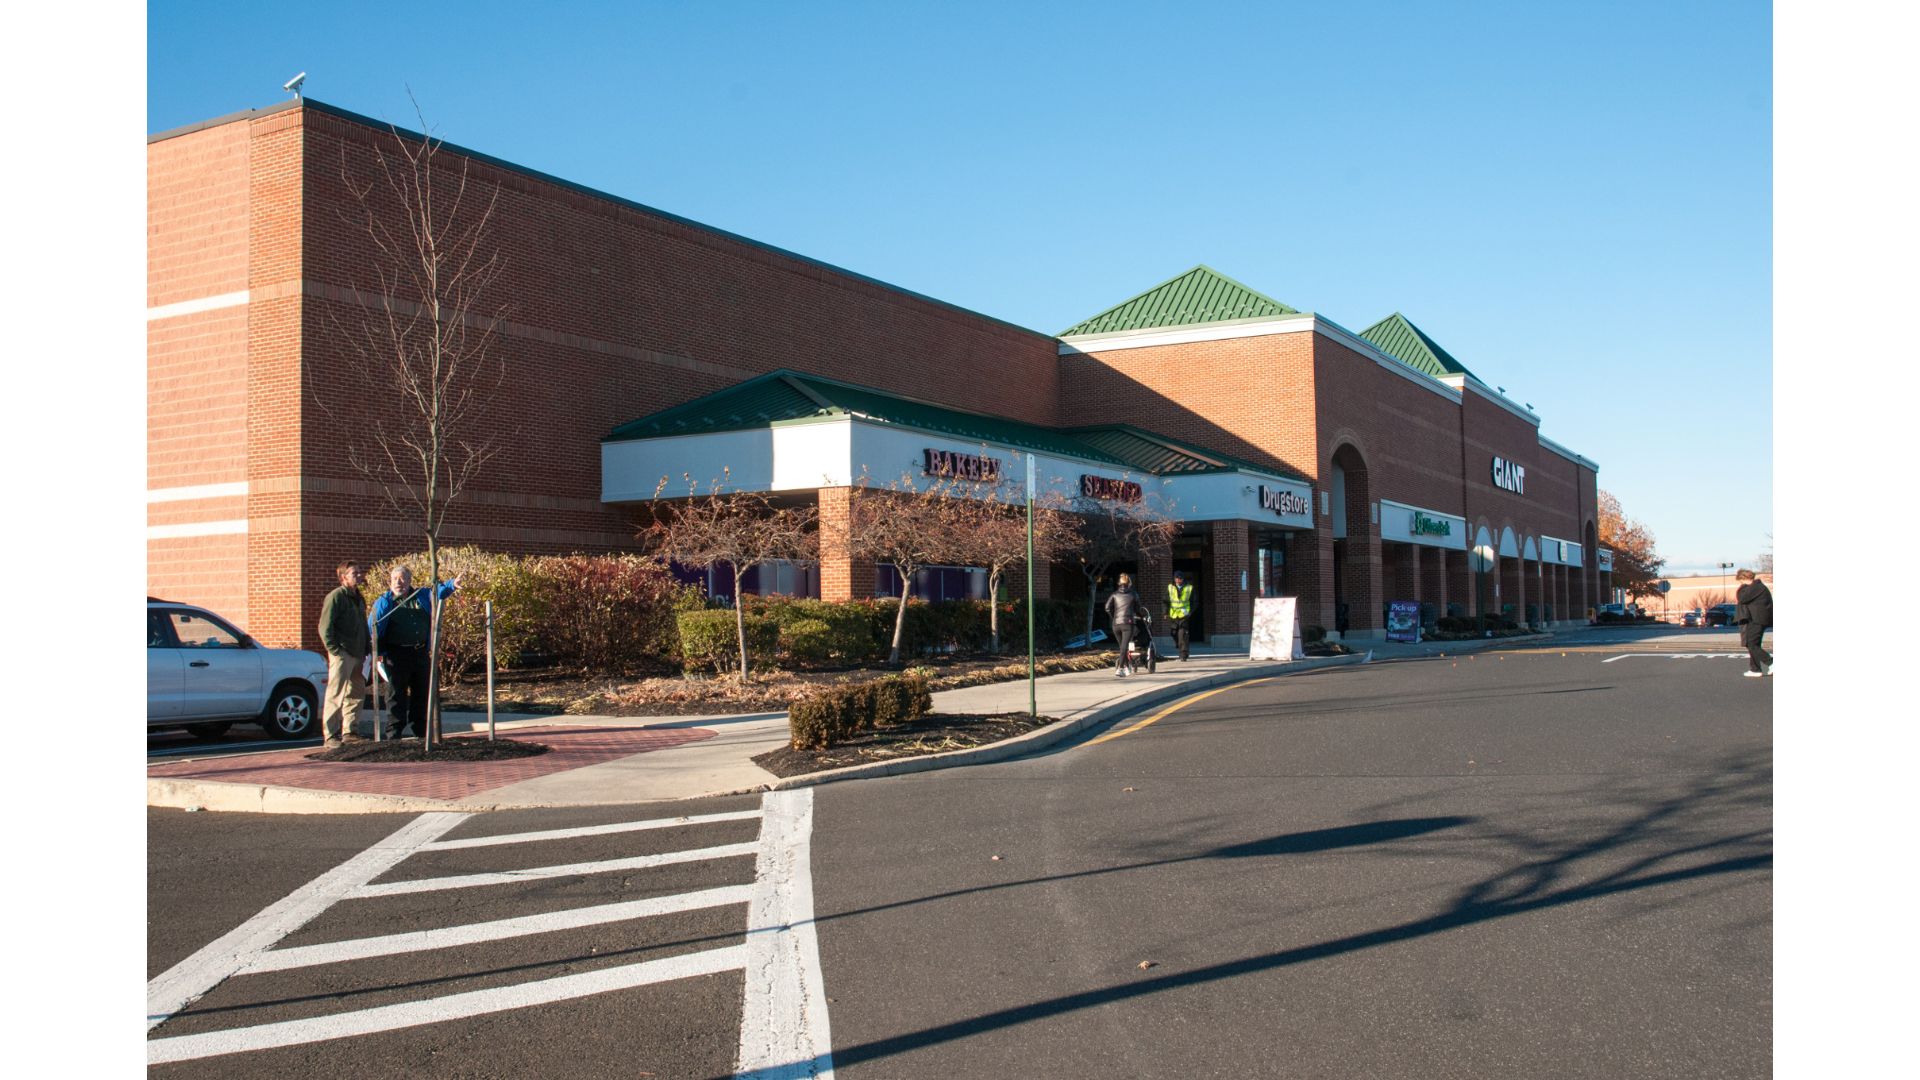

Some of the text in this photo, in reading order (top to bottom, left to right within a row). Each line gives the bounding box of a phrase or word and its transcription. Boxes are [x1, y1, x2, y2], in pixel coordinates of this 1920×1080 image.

[925, 448, 1002, 484] BAKERY
[1493, 456, 1525, 495] GIANT
[1261, 485, 1309, 516] Drugstore
